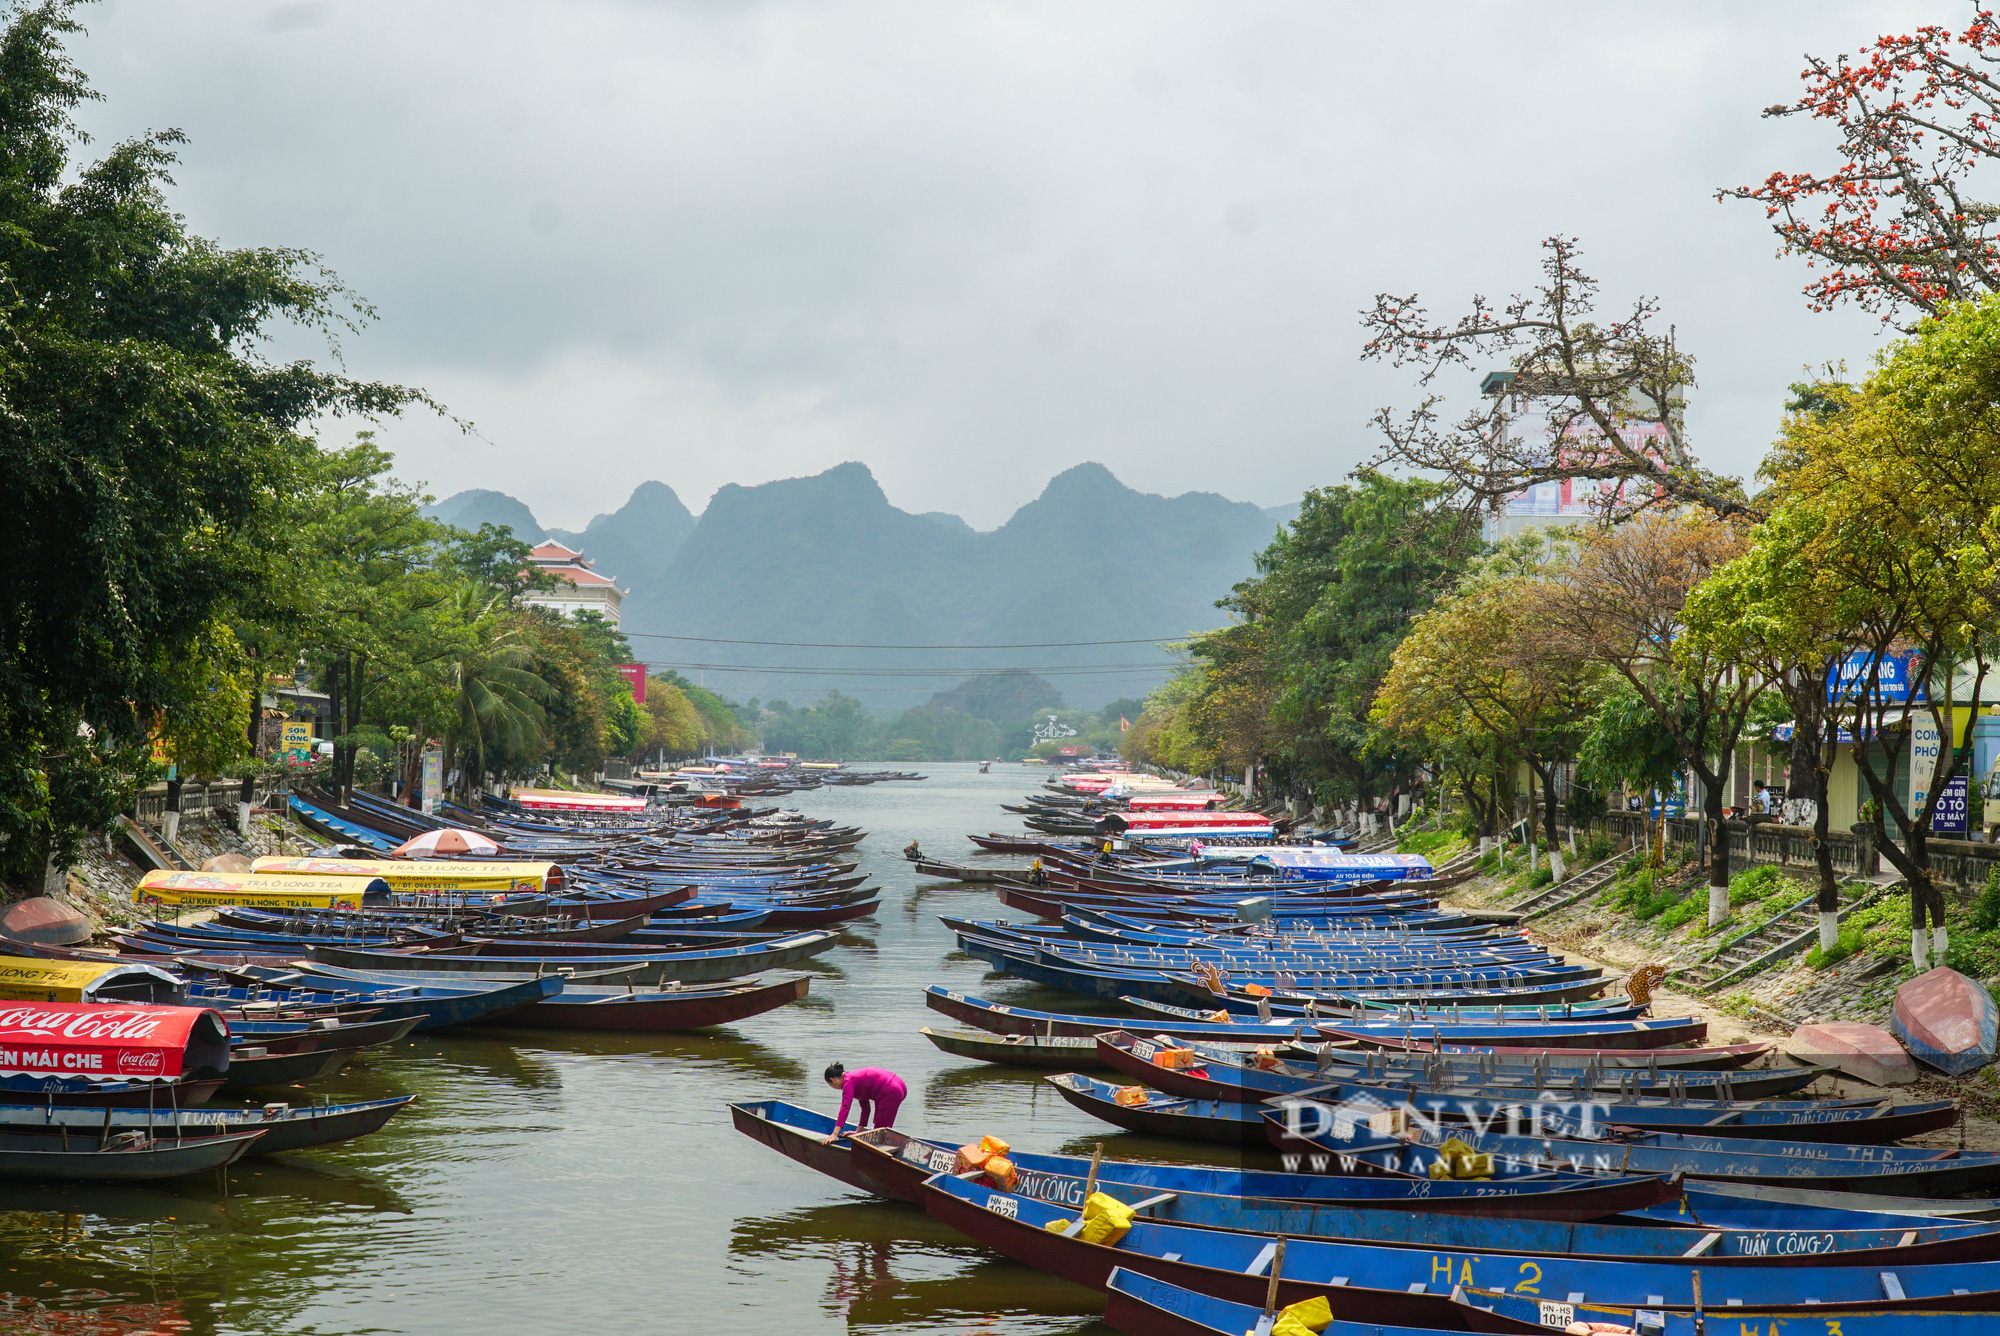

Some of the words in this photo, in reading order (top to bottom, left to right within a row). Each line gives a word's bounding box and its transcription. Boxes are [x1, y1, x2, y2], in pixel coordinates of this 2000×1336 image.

[1914, 729, 1939, 741] CƠM
[1914, 743, 1938, 757] PHỞ
[1936, 798, 1946, 811] Ô
[1949, 798, 1965, 811] TÔ
[1935, 813, 1945, 821] XE
[1947, 811, 1965, 821] MÁY
[283, 881, 316, 889] LONG
[196, 896, 217, 906] KHÁT
[242, 898, 256, 907] TRÀ
[257, 899, 281, 907] NÓNG
[0, 968, 39, 979] LONG
[40, 971, 69, 981] TEA
[1133, 1045, 1152, 1058] 3331
[22, 1049, 58, 1068] MÁI
[63, 1053, 103, 1069] CHE
[119, 1051, 162, 1067] Coca-Cola
[933, 1151, 944, 1160] HN
[1014, 1171, 1040, 1196] UẤN
[1040, 1176, 1084, 1205] CÔNG
[1407, 1180, 1432, 1199] X8
[990, 1196, 1002, 1204] HN
[1736, 1231, 1770, 1256] TUẤN
[1776, 1232, 1821, 1254] CÔNG
[1514, 1261, 1542, 1294] 2
[1543, 1305, 1554, 1313] HN
[1543, 1313, 1571, 1326] 1016
